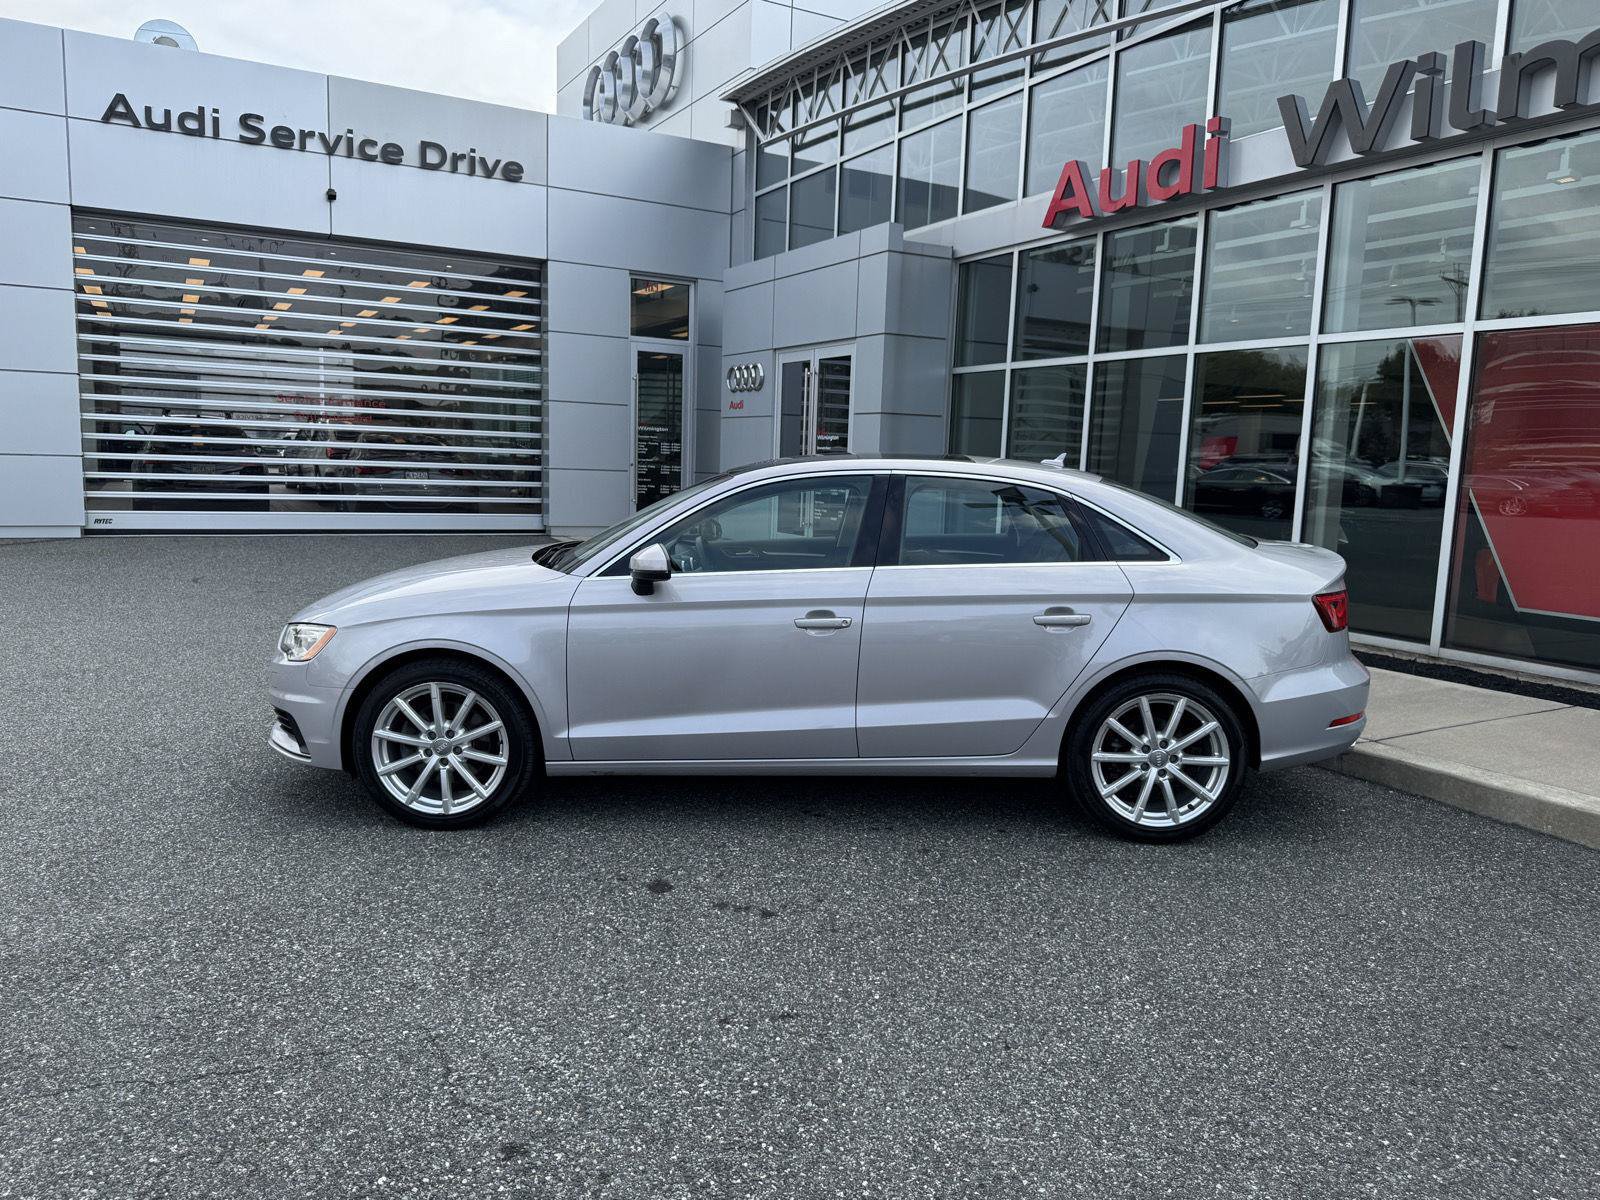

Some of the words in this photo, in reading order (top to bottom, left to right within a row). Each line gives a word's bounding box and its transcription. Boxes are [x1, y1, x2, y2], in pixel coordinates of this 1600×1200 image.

[100, 92, 220, 138] Audi
[238, 112, 405, 165] Service
[419, 139, 525, 183] Drive
[1042, 116, 1231, 229] Audi
[729, 400, 744, 410] Audi
